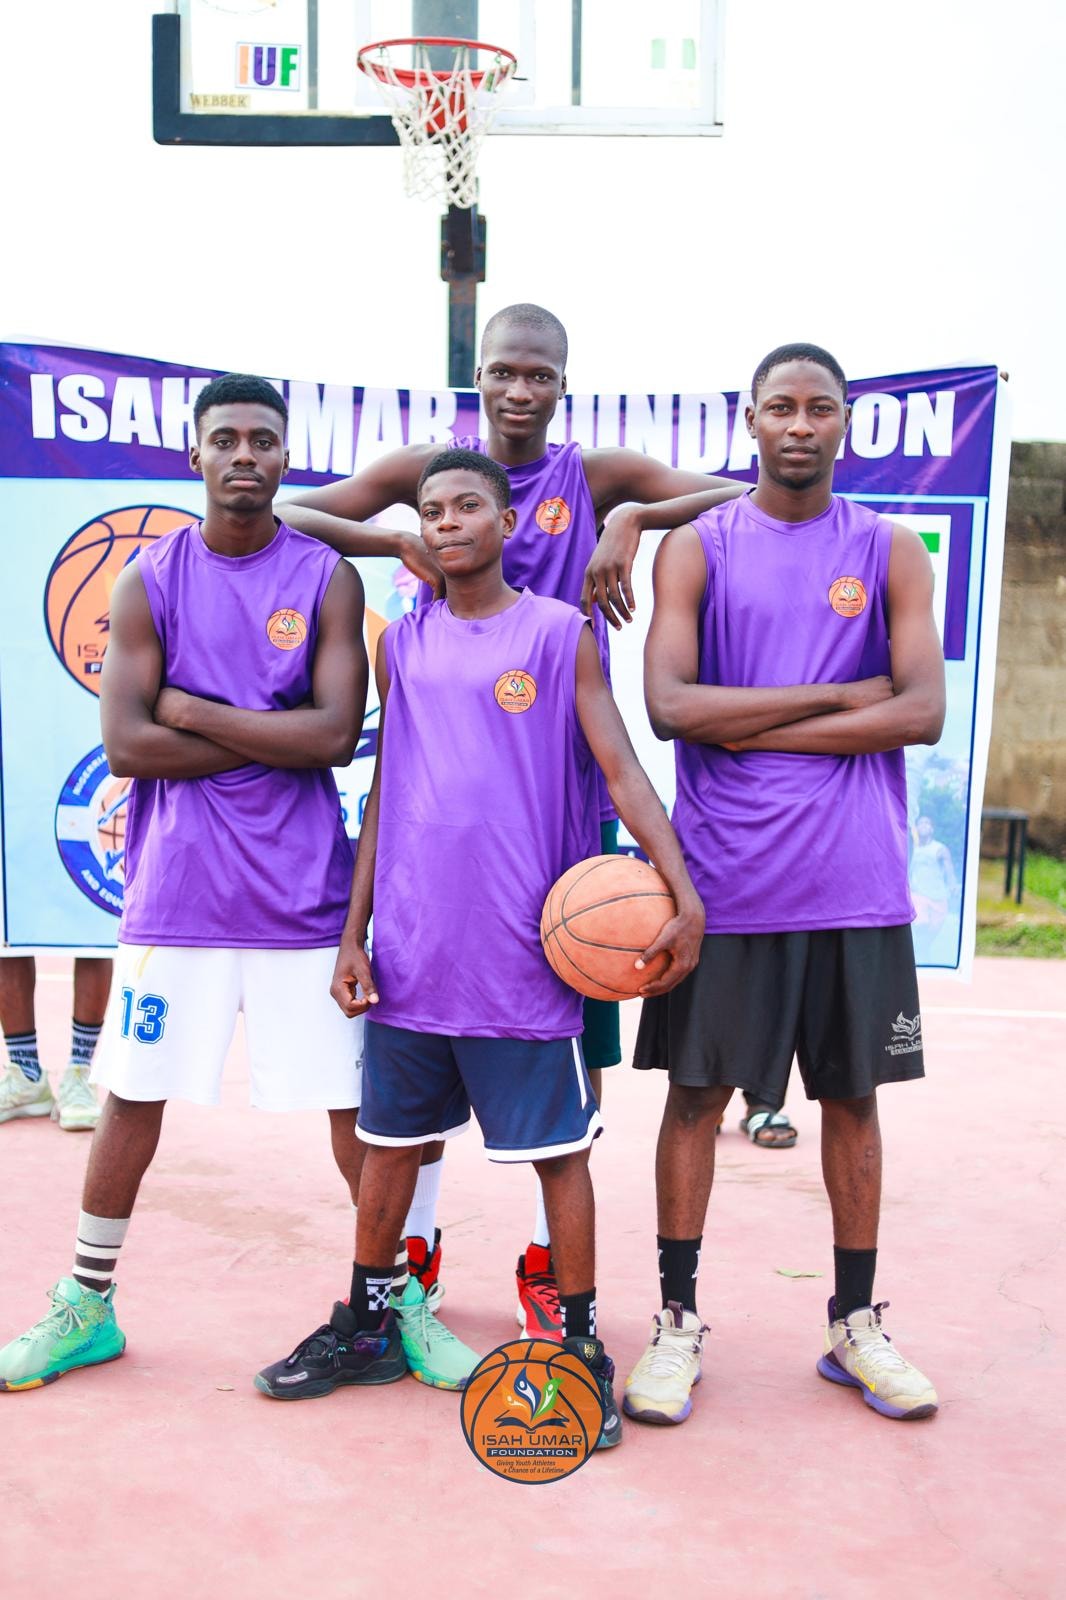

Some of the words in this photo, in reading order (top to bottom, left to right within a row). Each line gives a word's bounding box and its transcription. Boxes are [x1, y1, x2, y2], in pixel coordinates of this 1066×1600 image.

[239, 45, 298, 86] IUF
[30, 373, 211, 452] ISAH
[263, 379, 458, 477] MAR
[121, 986, 168, 1044] 13
